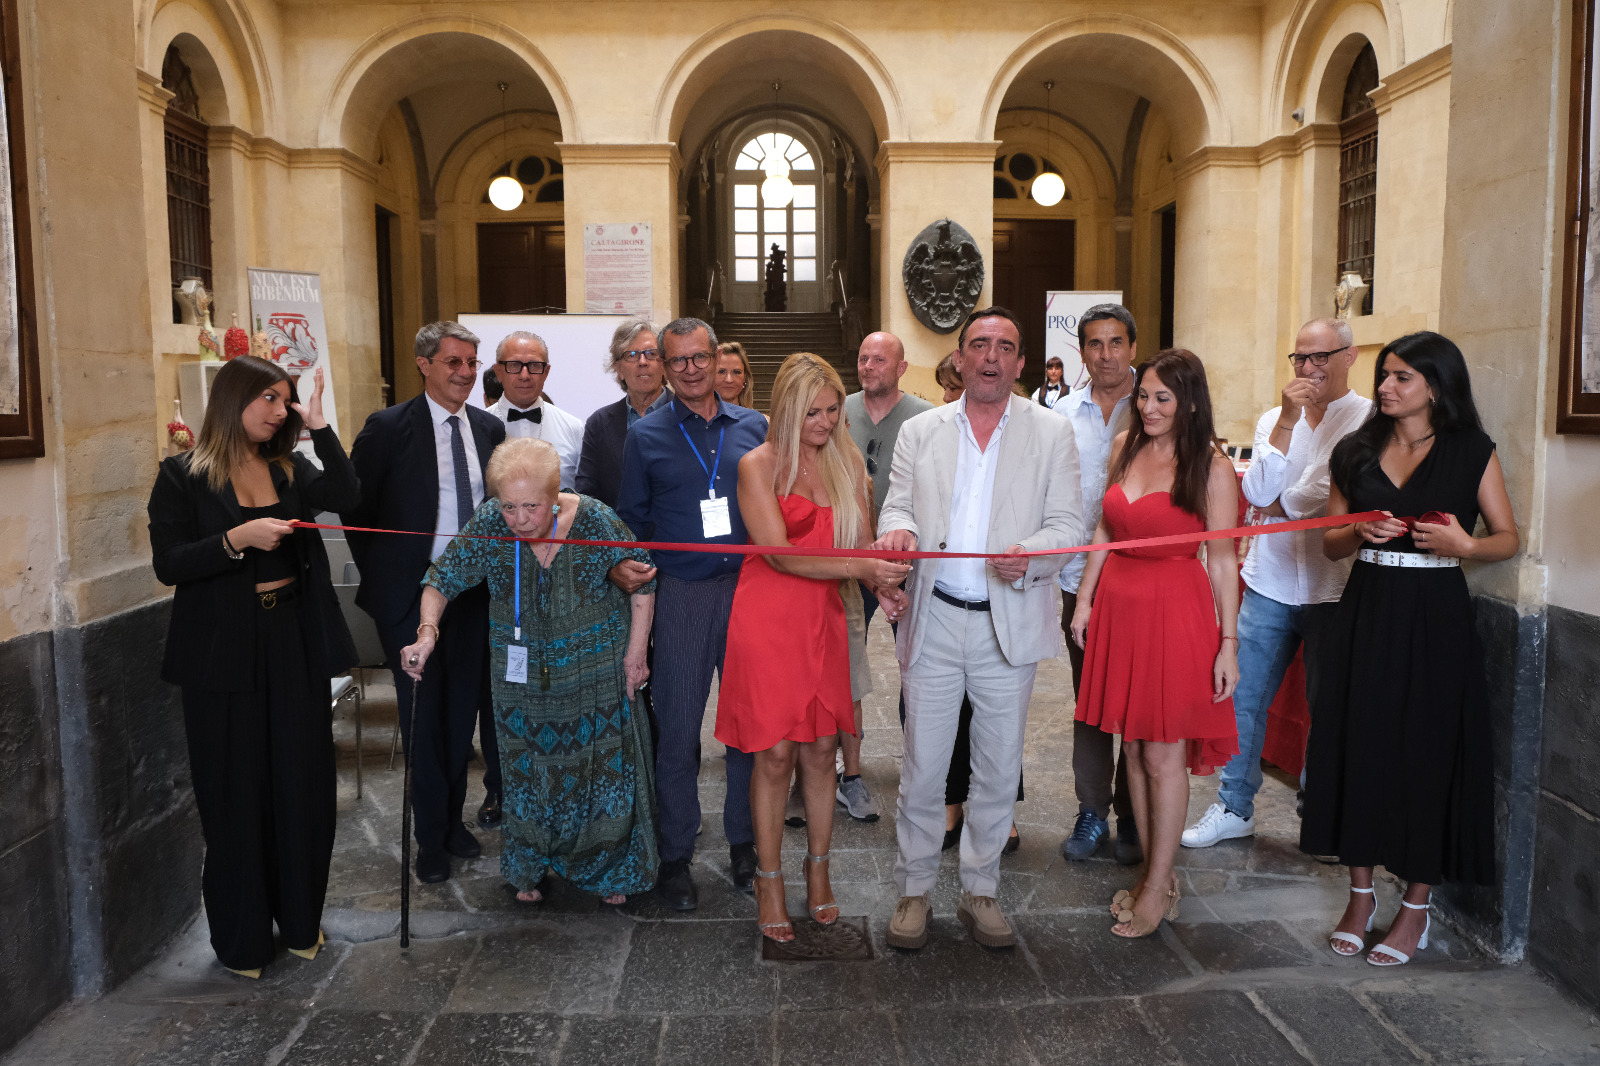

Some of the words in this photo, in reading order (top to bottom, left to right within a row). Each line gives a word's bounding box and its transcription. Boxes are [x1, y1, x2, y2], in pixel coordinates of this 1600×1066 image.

[253, 271, 287, 287] NUNC
[290, 274, 313, 289] EST
[252, 285, 320, 303] BIBENDUM
[1048, 315, 1077, 333] PRO
